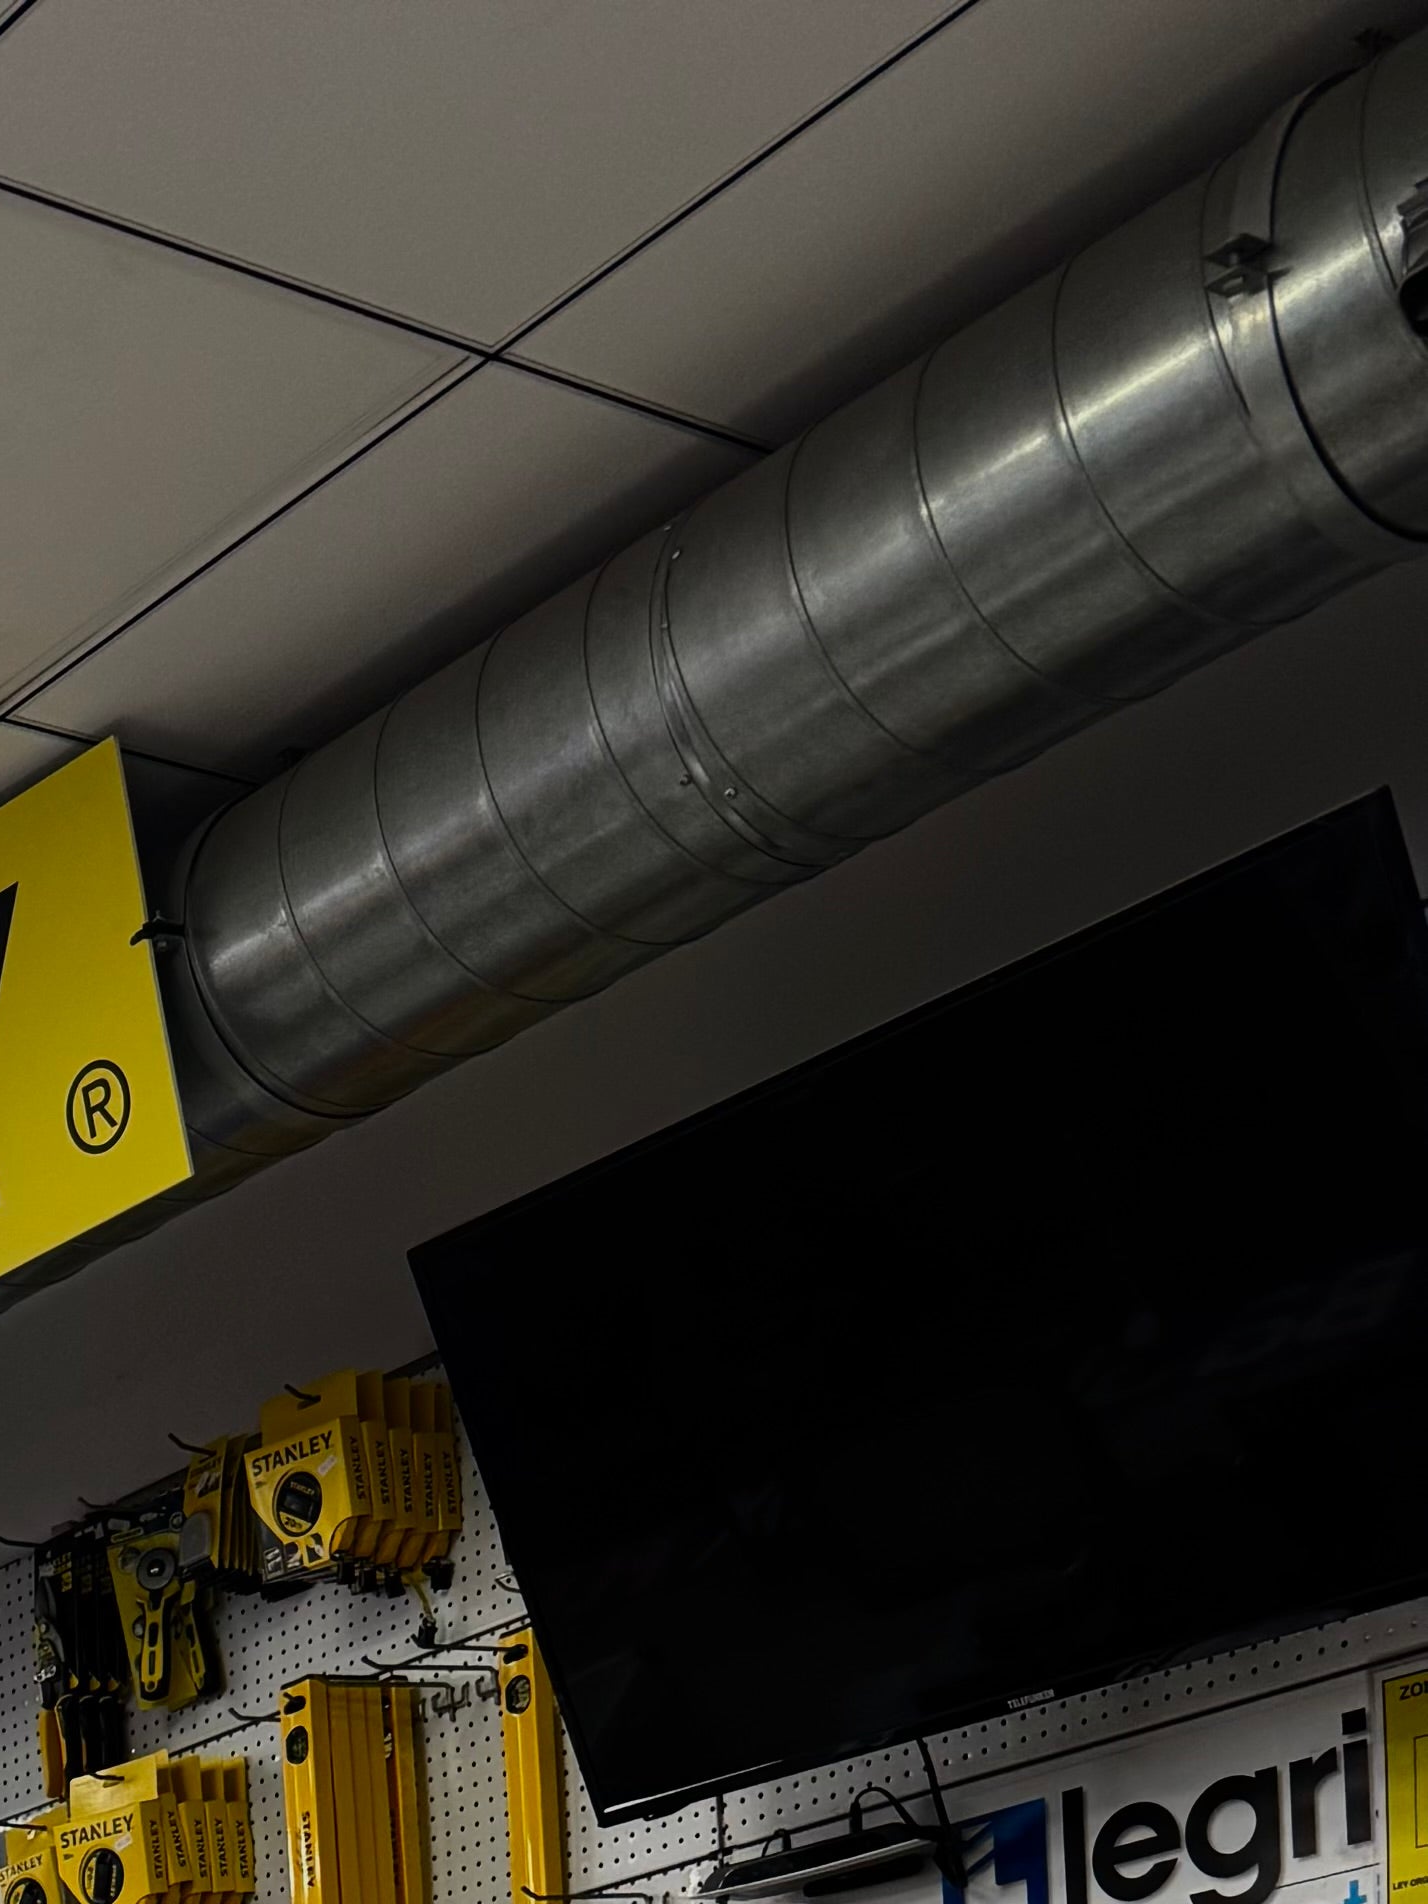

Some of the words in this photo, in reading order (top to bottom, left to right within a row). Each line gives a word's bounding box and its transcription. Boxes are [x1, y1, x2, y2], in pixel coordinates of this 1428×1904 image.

[252, 1430, 333, 1477] STANLEY
[349, 1436, 366, 1500] STANLEY
[376, 1440, 391, 1505] STANLEY
[399, 1448, 413, 1514] STANLEY
[441, 1450, 458, 1515] STANLEY
[423, 1452, 434, 1518] STANLEY
[1399, 1681, 1428, 1700] ZO
[60, 1813, 134, 1849] STANLEY
[149, 1819, 164, 1879] STANLEY
[166, 1810, 186, 1868] STANLEY
[194, 1817, 208, 1879] STANLEY
[215, 1817, 228, 1878] STANLEY
[236, 1819, 250, 1879] STANLEY
[0, 1854, 44, 1884] STANLEY
